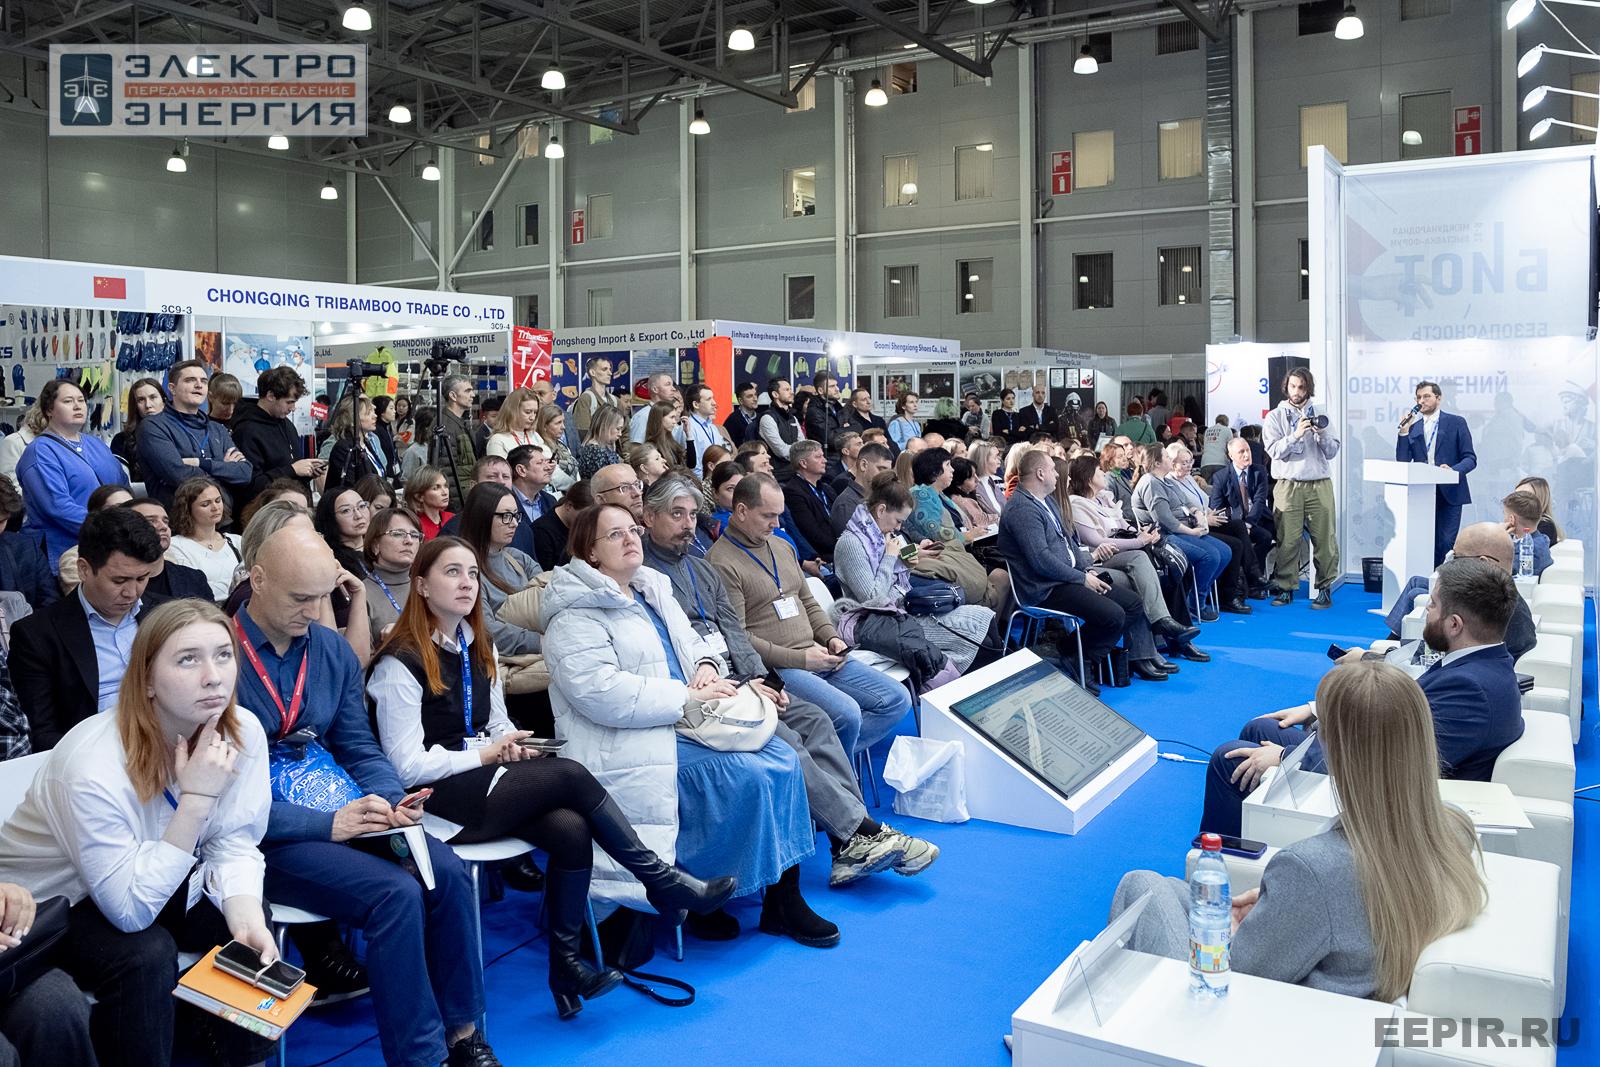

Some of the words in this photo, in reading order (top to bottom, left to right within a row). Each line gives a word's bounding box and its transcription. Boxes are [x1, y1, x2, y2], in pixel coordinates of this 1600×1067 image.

[161, 304, 193, 315] 3C9-3
[207, 288, 310, 307] CHONGQING
[315, 295, 402, 314] TRIBAMBOO
[406, 302, 449, 317] TRADE
[490, 322, 511, 331] 3C9-4
[392, 338, 431, 349] SHANDONG
[469, 334, 496, 344] TEXTILE
[551, 334, 596, 348] Yongsheng
[598, 333, 628, 346] Import
[629, 333, 636, 343] &
[638, 331, 670, 344] Export
[731, 330, 750, 339] Jinhua
[750, 331, 778, 342] Yongsheng
[778, 333, 796, 342] Import
[801, 335, 817, 344] Export
[986, 350, 1020, 358] Retardant
[1348, 376, 1402, 395] ОВЫХ
[1409, 370, 1508, 395] РЕНИЙ
